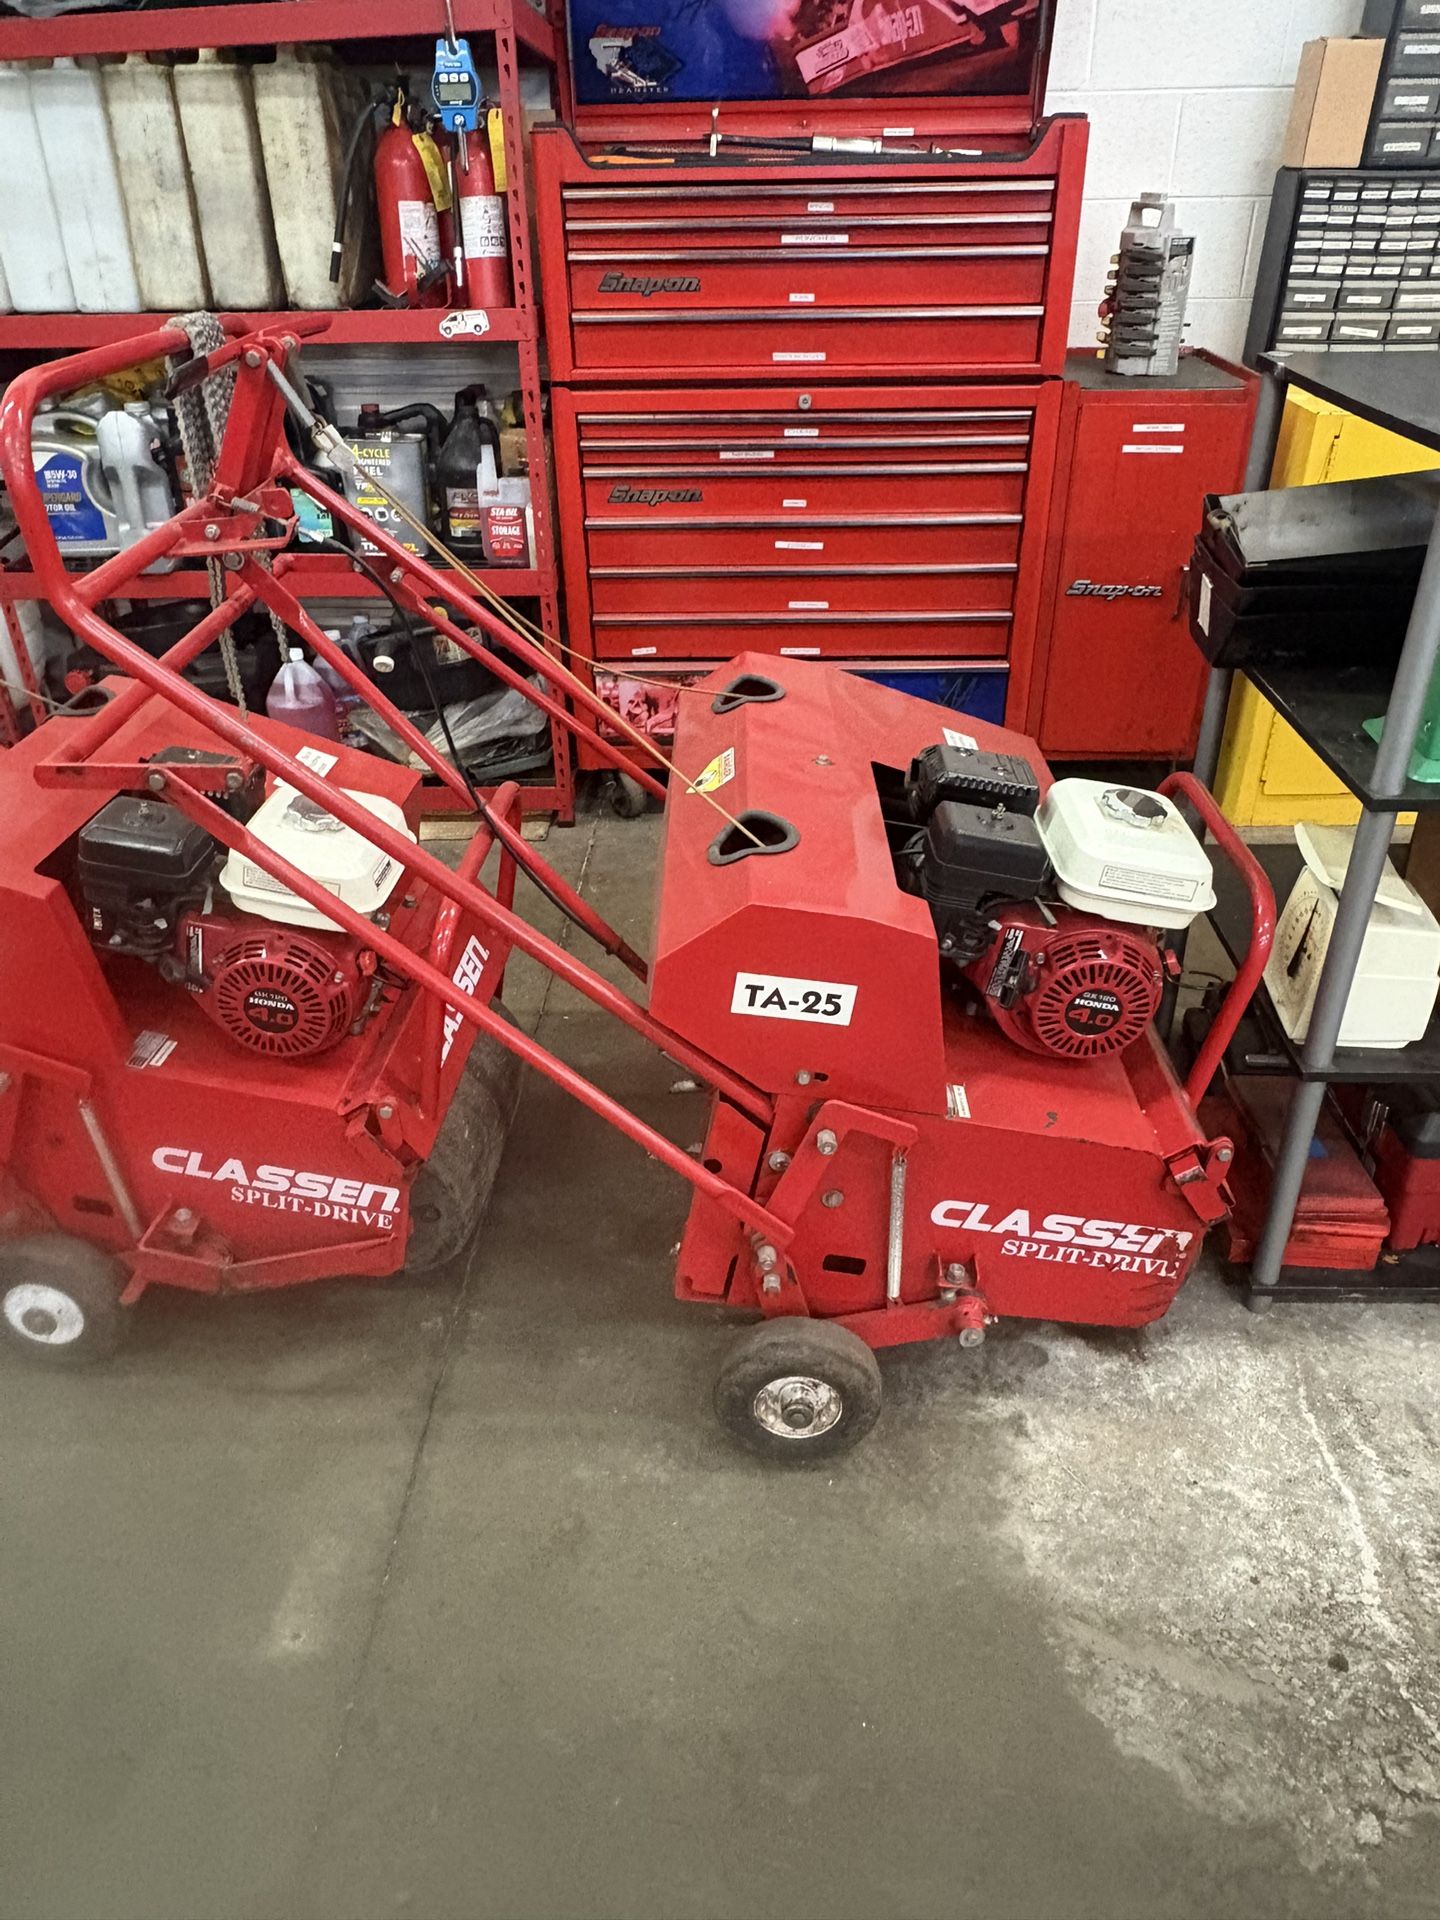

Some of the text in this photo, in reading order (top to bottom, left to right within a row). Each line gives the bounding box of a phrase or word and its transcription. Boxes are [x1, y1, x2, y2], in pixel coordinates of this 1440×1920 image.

[352, 443, 391, 458] 4-CYCLE
[491, 525, 521, 535] STORAGE
[248, 997, 295, 1011] HONDA
[744, 984, 843, 1016] TA-25
[1074, 998, 1120, 1012] HONDA
[248, 1008, 294, 1025] 4.0
[1068, 1008, 1114, 1027] 4.0
[151, 1146, 401, 1214] CLASSEN
[230, 1185, 393, 1230] SPLIT-DRIVE
[1001, 1238, 1180, 1280] SPLIT-DRIVE
